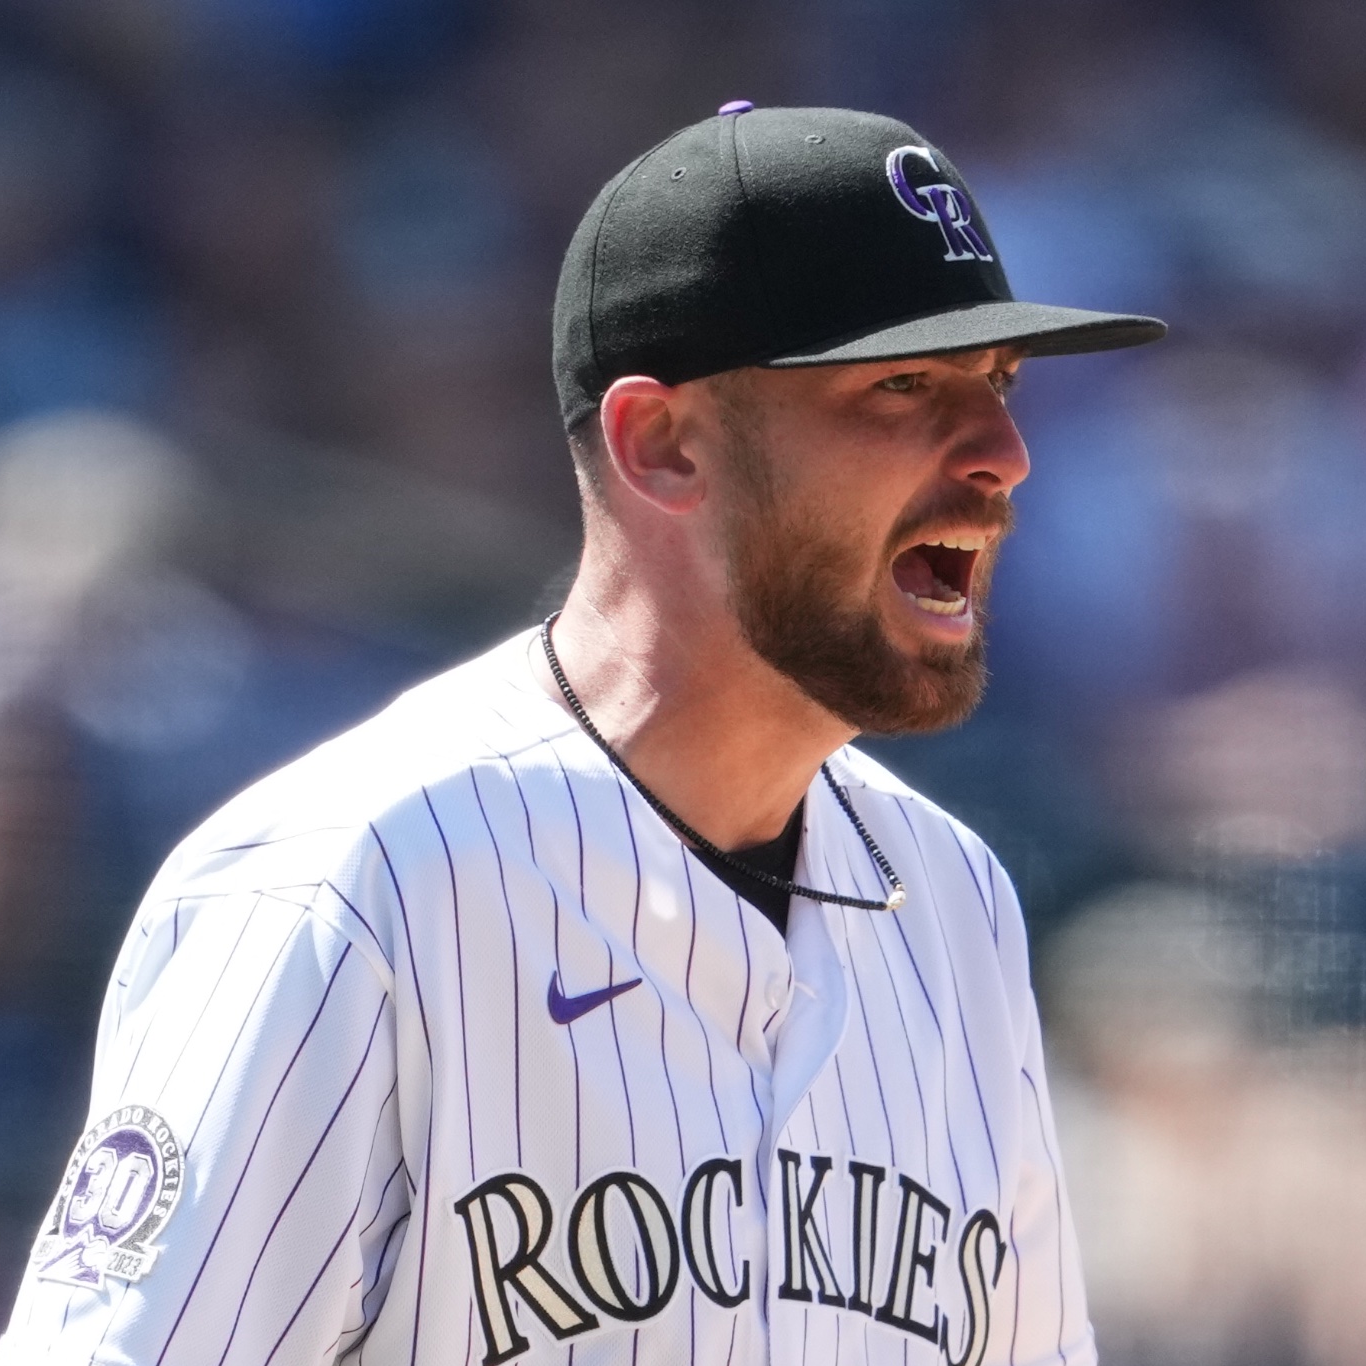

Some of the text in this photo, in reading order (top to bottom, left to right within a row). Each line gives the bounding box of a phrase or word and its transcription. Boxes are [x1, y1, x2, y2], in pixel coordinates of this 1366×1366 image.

[886, 145, 993, 262] CR
[69, 1147, 154, 1231] 30
[146, 1112, 181, 1218] ROCKIES
[106, 1252, 142, 1277] 2023
